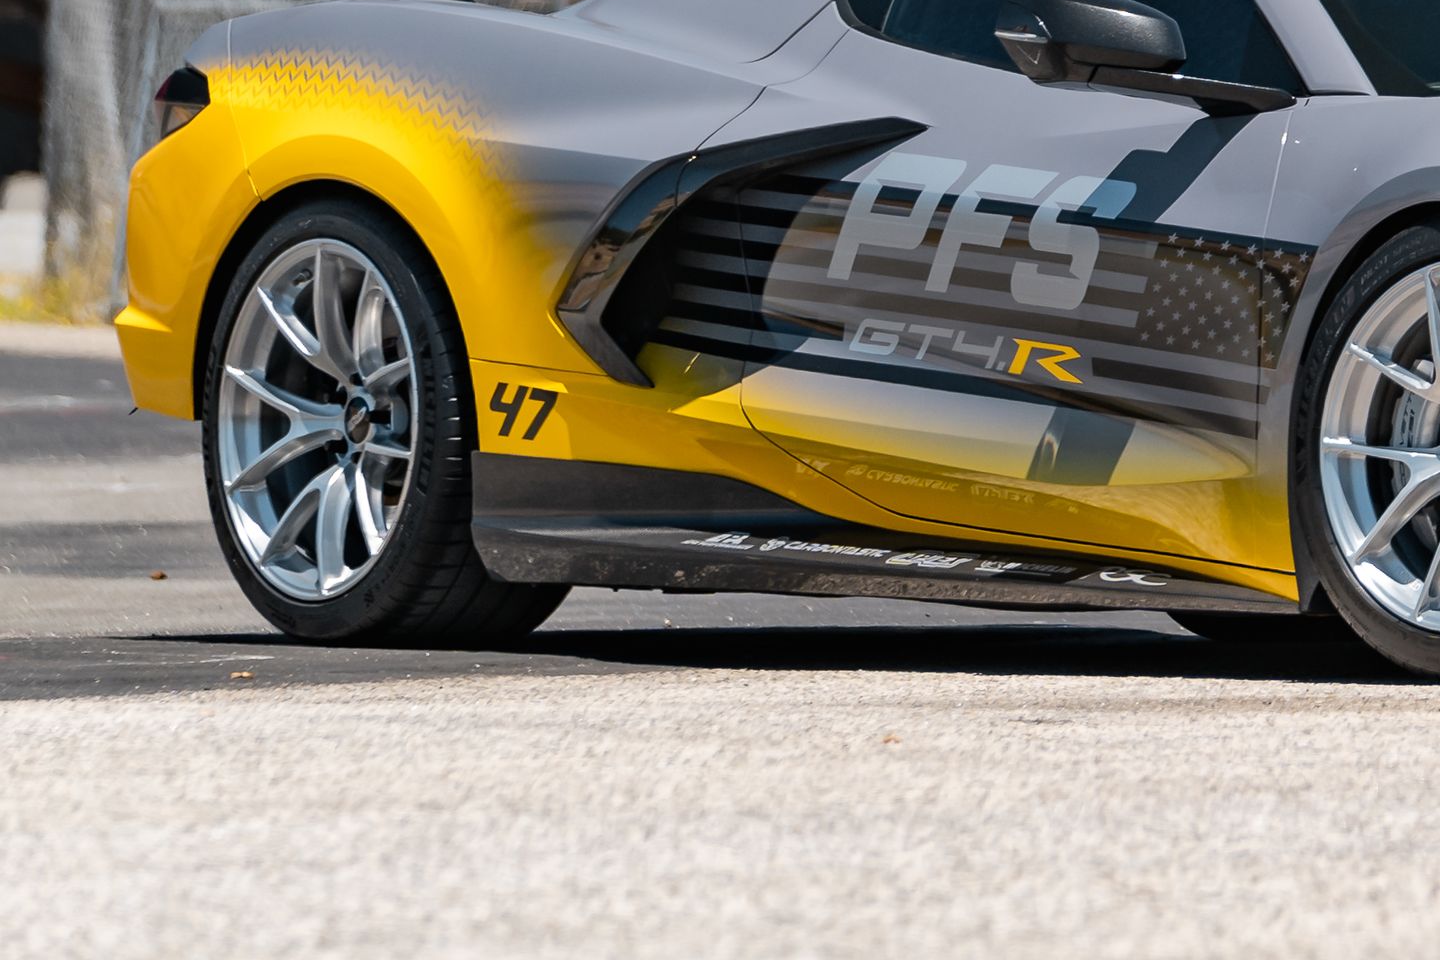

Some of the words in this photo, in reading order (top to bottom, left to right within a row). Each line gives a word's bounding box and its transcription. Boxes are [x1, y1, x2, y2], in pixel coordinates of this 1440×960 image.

[827, 152, 1137, 310] PFS
[490, 382, 558, 441] 47
[783, 541, 892, 558] CARBONTASTIC
